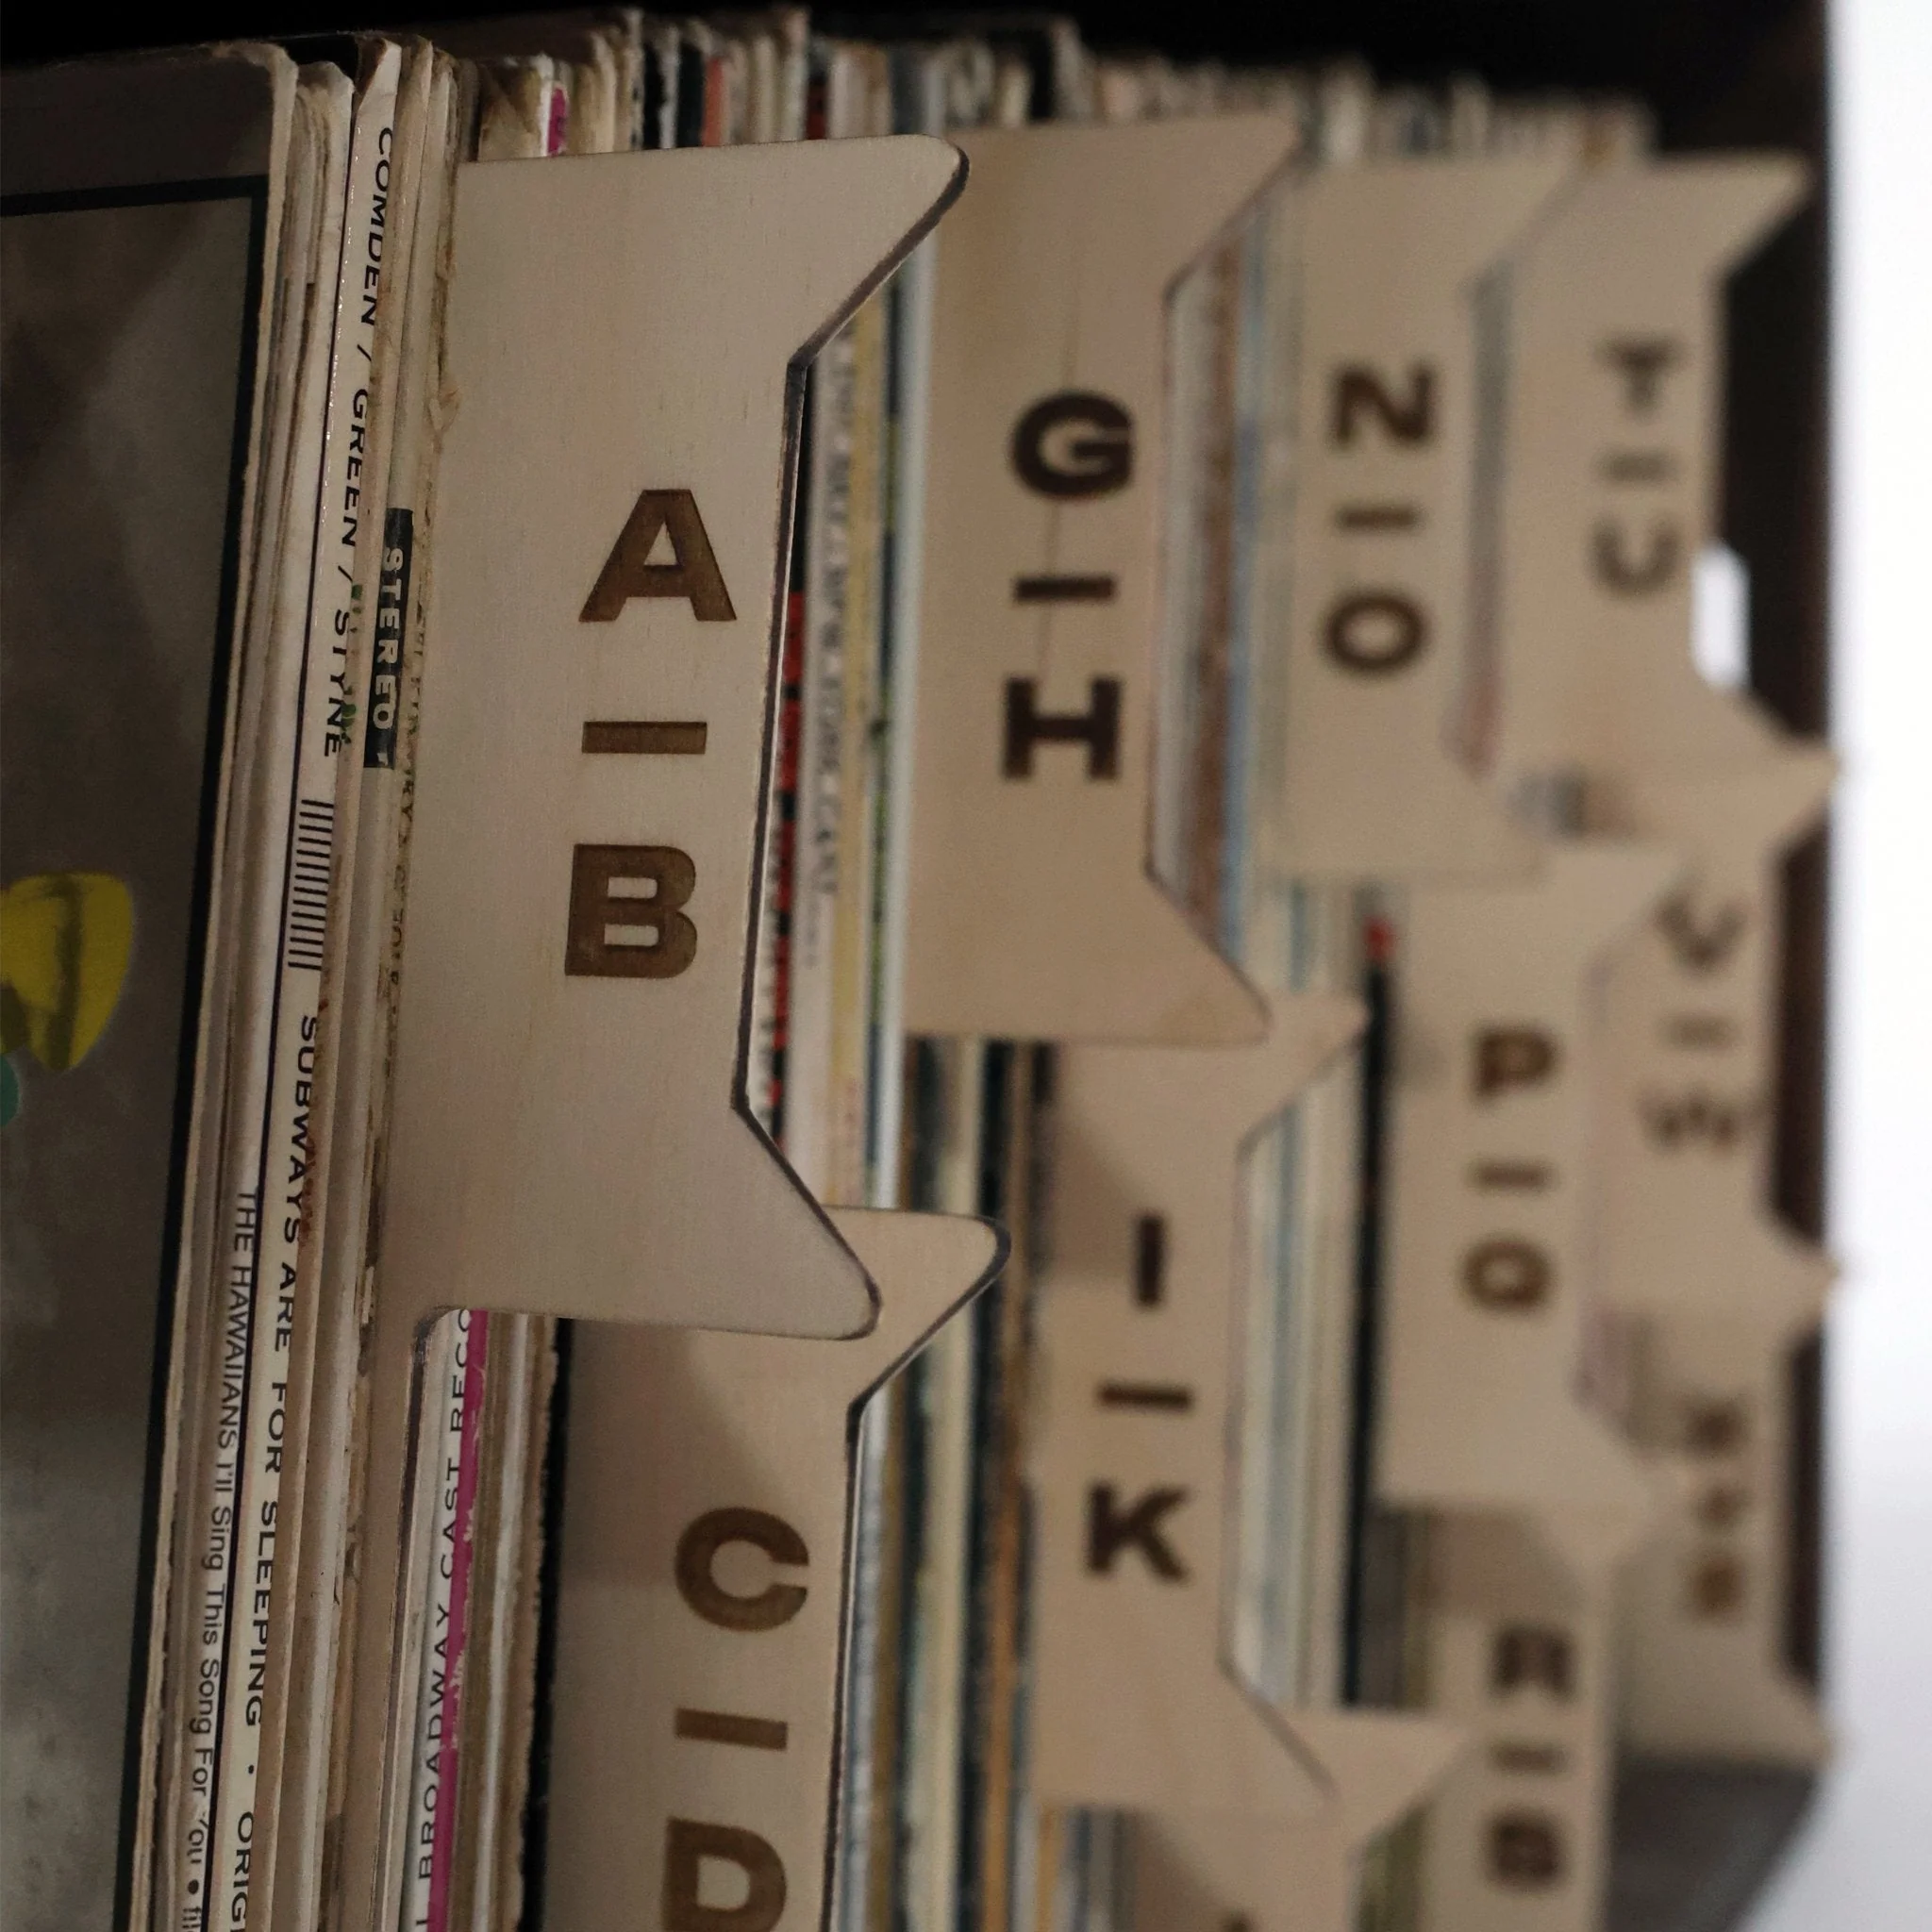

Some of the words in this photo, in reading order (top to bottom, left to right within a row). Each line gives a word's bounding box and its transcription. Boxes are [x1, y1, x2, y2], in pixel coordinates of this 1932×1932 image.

[361, 126, 393, 326] COMDEN
[1012, 391, 1134, 500] G
[1329, 361, 1437, 447] N
[341, 388, 370, 546] GREEN
[578, 489, 737, 623] A
[373, 546, 404, 730] STEREO
[1324, 590, 1429, 675] O
[1000, 675, 1123, 781] H
[564, 843, 698, 979] B
[283, 1015, 317, 1244] SUBWAYS
[234, 1192, 258, 1252] THE
[218, 1266, 253, 1450] HAWAIIANS
[275, 1261, 297, 1353] ARE
[265, 1382, 287, 1474] FOR
[202, 1507, 231, 1572] Sing
[675, 1507, 809, 1631] C
[1085, 1481, 1190, 1585] K
[202, 1584, 226, 1645] This
[245, 1500, 280, 1726] SLEEPING
[190, 1658, 220, 1734] Song
[419, 1604, 451, 1879] BROADWAY
[440, 1457, 461, 1581] CAST
[192, 1749, 215, 1796] For
[662, 1817, 787, 1932] D
